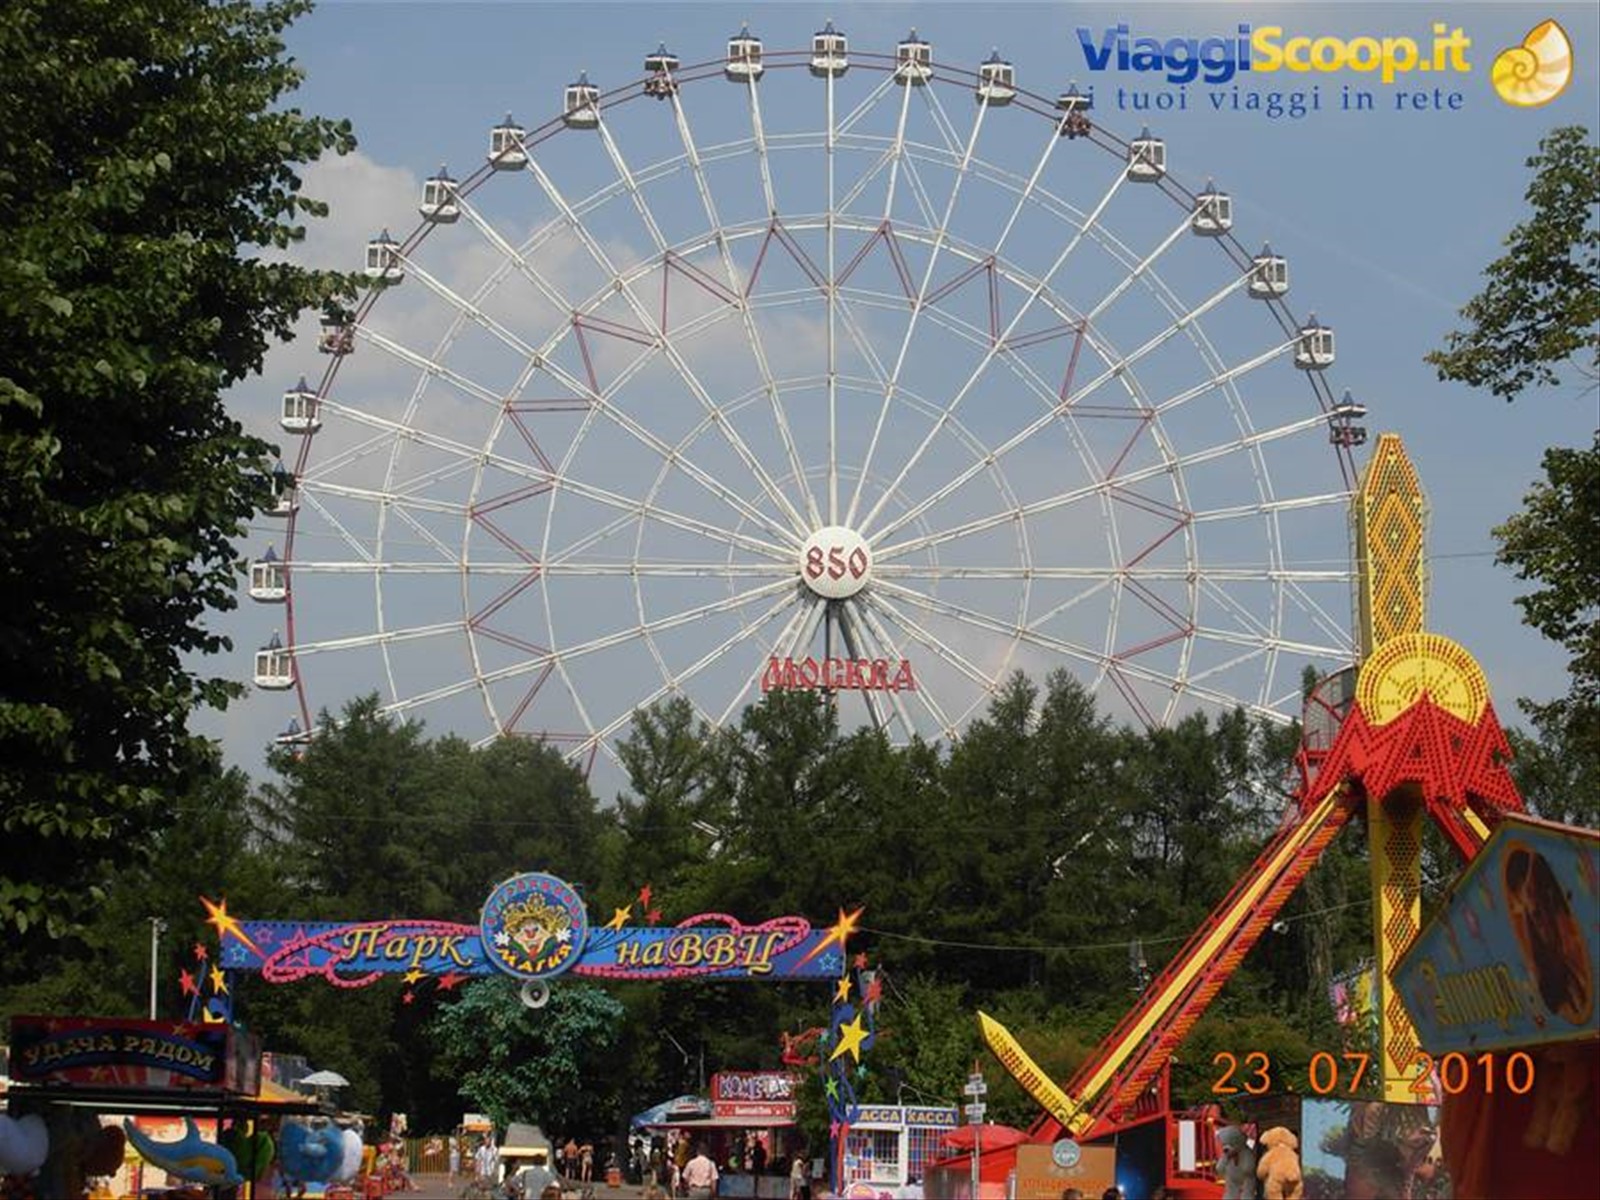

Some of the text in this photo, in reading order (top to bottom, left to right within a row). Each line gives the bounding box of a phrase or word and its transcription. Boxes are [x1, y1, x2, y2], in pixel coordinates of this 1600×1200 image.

[806, 545, 868, 581] 850
[342, 924, 473, 967] Парк
[858, 1110, 900, 1122] АССА
[907, 1110, 955, 1124] КАССА
